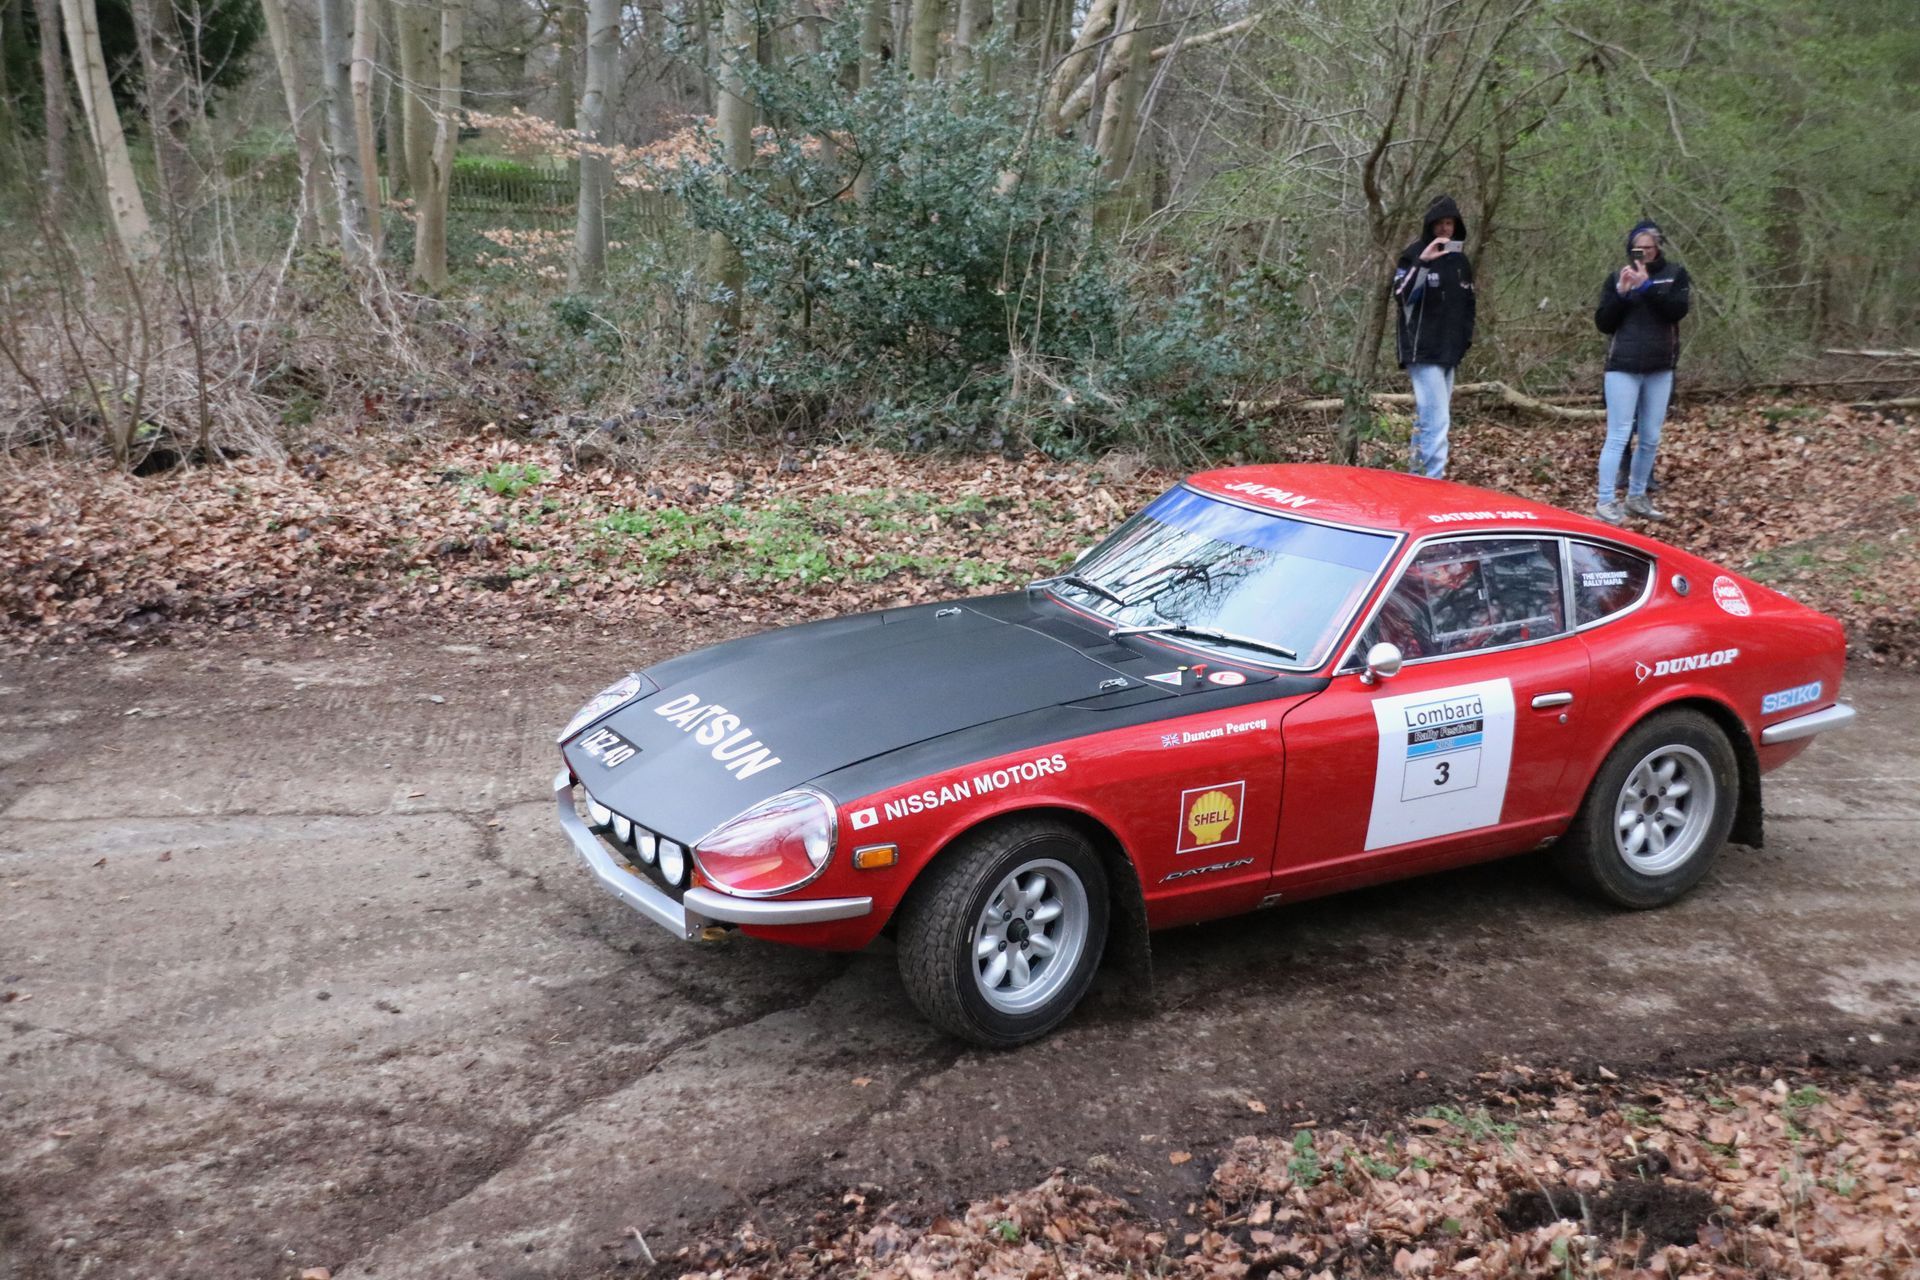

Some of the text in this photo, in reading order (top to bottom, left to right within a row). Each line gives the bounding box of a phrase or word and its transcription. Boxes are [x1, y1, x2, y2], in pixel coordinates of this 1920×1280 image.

[1224, 482, 1317, 508] JAPAN
[1427, 511, 1496, 523] DATSUN
[1583, 578, 1623, 587] RALLY MAFIA
[1595, 571, 1628, 579] YORKSHIRE
[1653, 648, 1739, 677] DUNLOP
[1762, 682, 1821, 713] SEIKO
[1404, 697, 1483, 727] Lombard
[653, 693, 782, 781] DATSUN
[1182, 718, 1267, 744] Duncan Pearcey
[1414, 721, 1477, 742] Rally Festival
[1433, 761, 1450, 786] 3
[884, 754, 1067, 821] NISSAN MOTORS
[1193, 810, 1230, 827] SHELL
[1159, 857, 1254, 883] DATSUN
